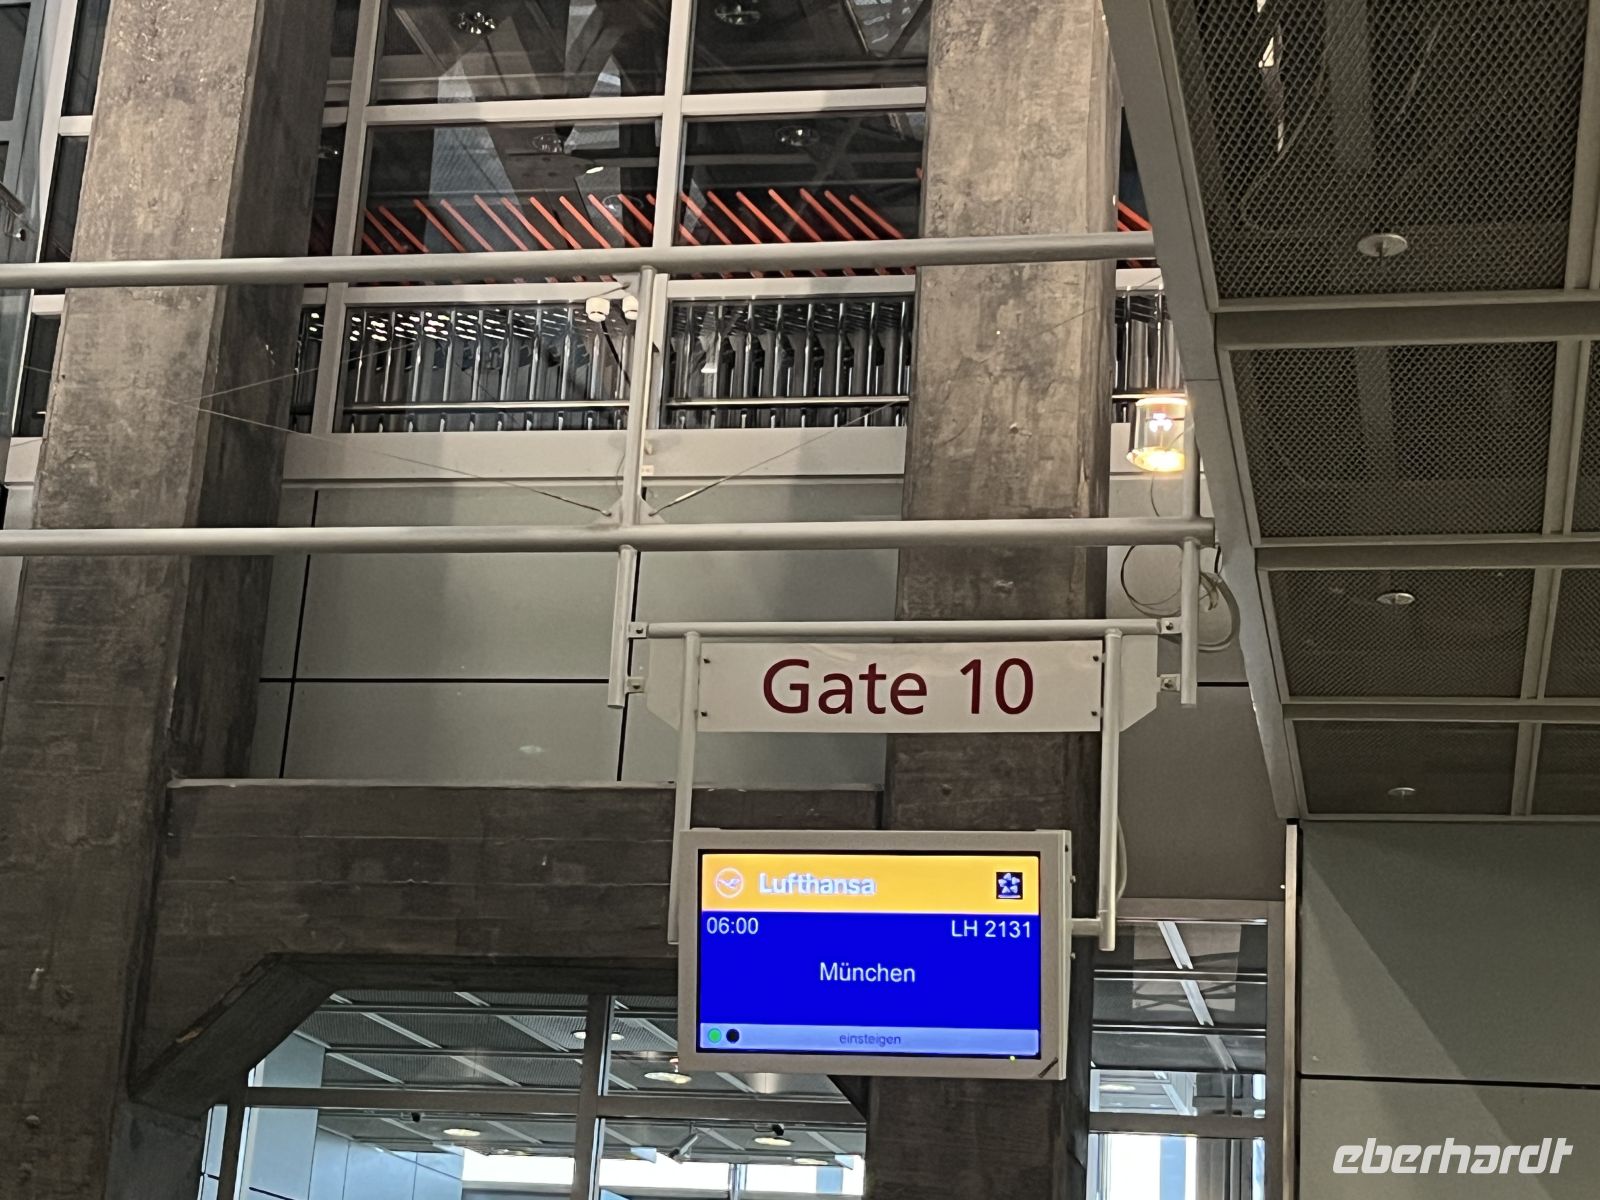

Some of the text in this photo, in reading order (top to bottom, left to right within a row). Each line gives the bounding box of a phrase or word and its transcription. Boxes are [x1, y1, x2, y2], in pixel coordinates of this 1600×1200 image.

[763, 657, 1034, 715] Gate 10
[758, 873, 877, 896] Lufthansa
[706, 916, 759, 936] 06:00
[951, 919, 1032, 939] LH 2131
[819, 962, 915, 982] München
[839, 1033, 901, 1047] einsteigen
